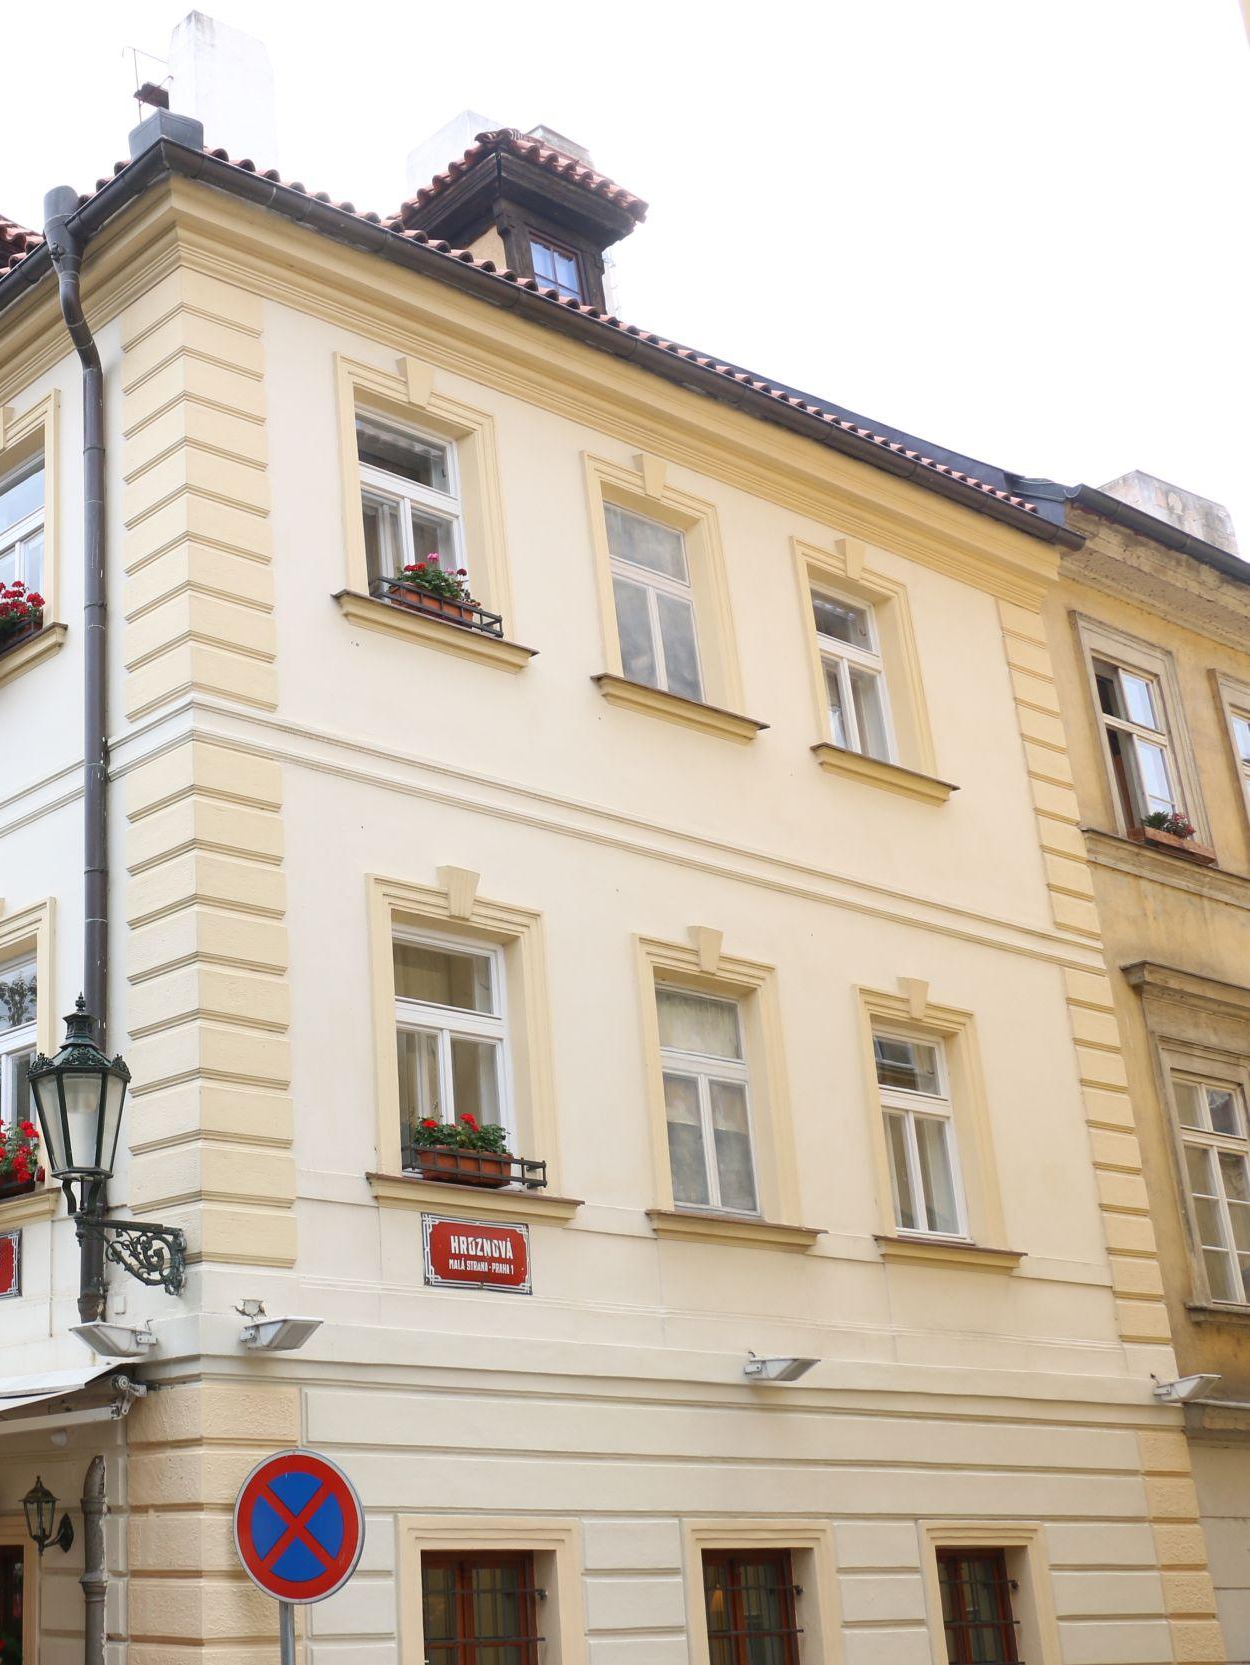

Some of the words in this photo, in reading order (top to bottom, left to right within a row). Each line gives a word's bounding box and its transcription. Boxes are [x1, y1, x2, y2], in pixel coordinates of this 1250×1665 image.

[450, 1235, 514, 1260] HROZNOVÁ
[449, 1258, 465, 1271] MALÁ
[466, 1260, 488, 1272] STRANA
[491, 1262, 510, 1275] PRAHA
